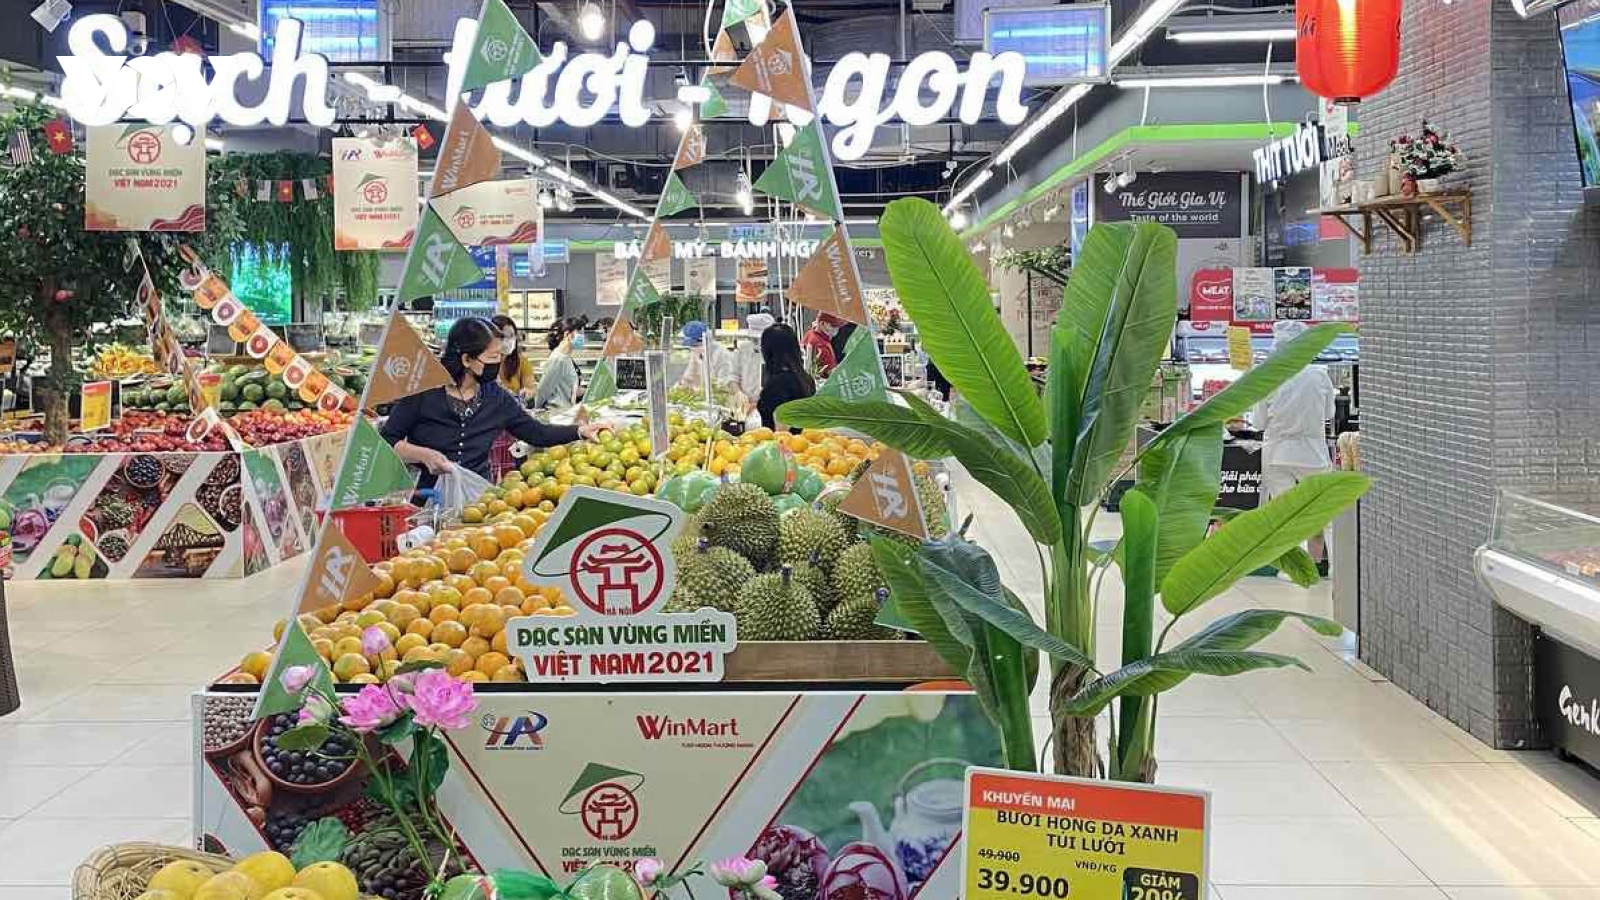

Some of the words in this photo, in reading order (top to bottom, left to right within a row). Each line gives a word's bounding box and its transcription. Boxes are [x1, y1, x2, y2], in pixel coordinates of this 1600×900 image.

[1119, 189, 1146, 207] Thế
[1147, 191, 1179, 210] Giới
[1180, 191, 1206, 210] Gia
[1208, 191, 1227, 209] Vị
[1130, 214, 1156, 223] Taste
[1158, 213, 1170, 222] of
[1171, 213, 1188, 222] the
[1190, 213, 1219, 222] world
[721, 236, 777, 258] BÁNH
[608, 622, 667, 645] VÙNG
[533, 650, 582, 681] VIỆT
[590, 653, 647, 676] NAM
[649, 651, 714, 674] 2021
[636, 715, 739, 740] WinMart
[982, 790, 1042, 808] KHUYẾN
[1130, 826, 1179, 843] XANH
[978, 848, 1021, 862] 49.900
[977, 868, 1070, 899] 39.900
